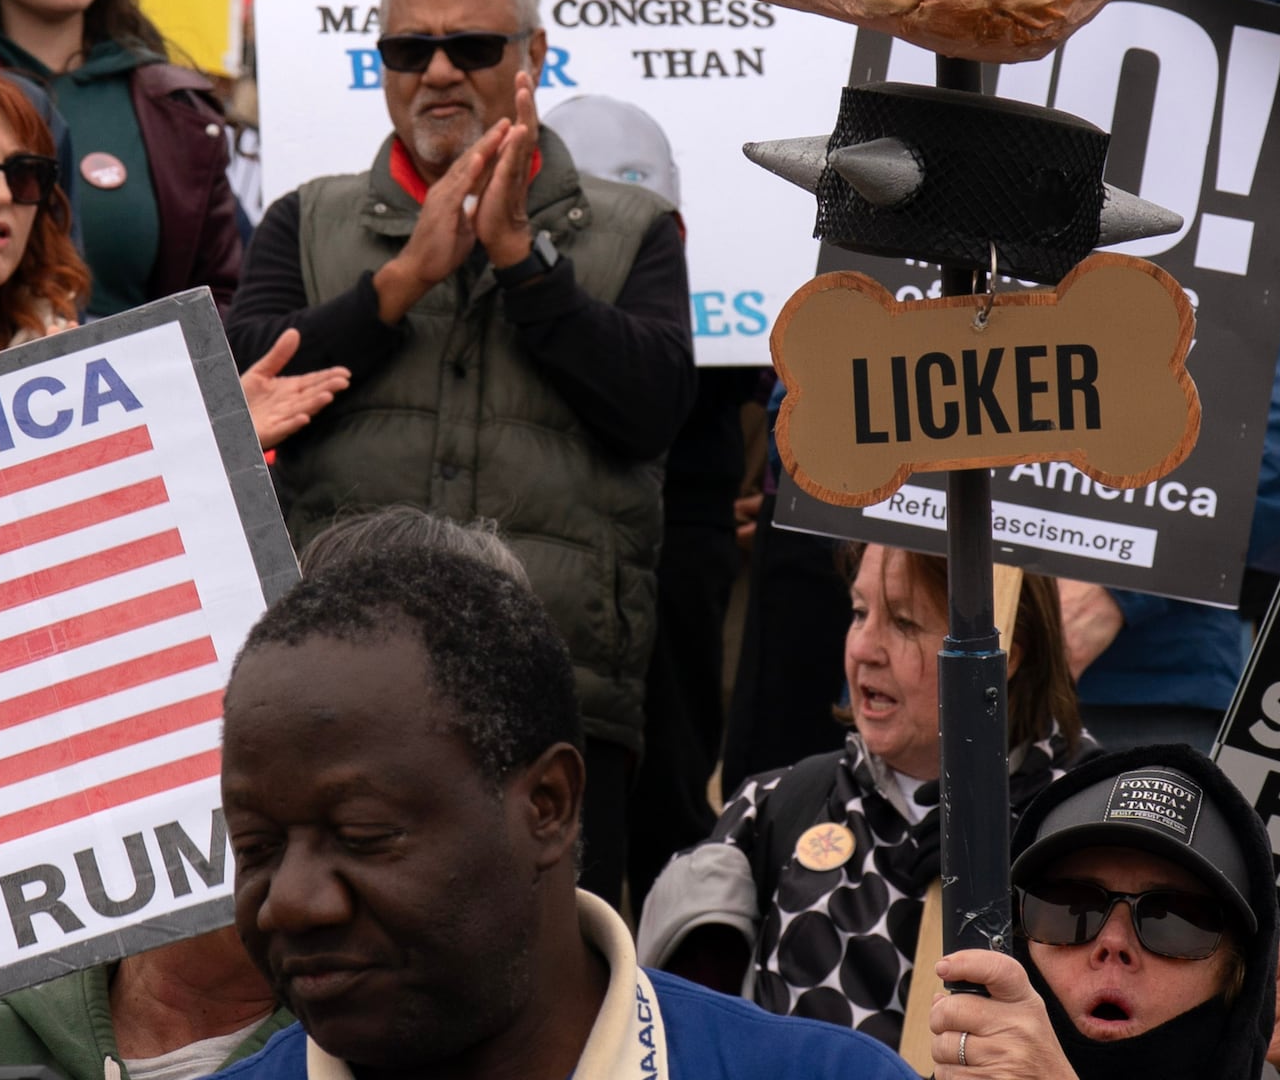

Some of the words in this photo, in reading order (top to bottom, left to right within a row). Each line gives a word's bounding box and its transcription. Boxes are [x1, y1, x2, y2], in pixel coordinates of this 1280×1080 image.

[633, 47, 765, 80] THAN
[852, 344, 1102, 445] LICKER
[1120, 780, 1196, 802] FOXTROT
[1131, 790, 1177, 809] DELTA
[1126, 800, 1177, 819] TANGO
[636, 984, 658, 1080] AACP
